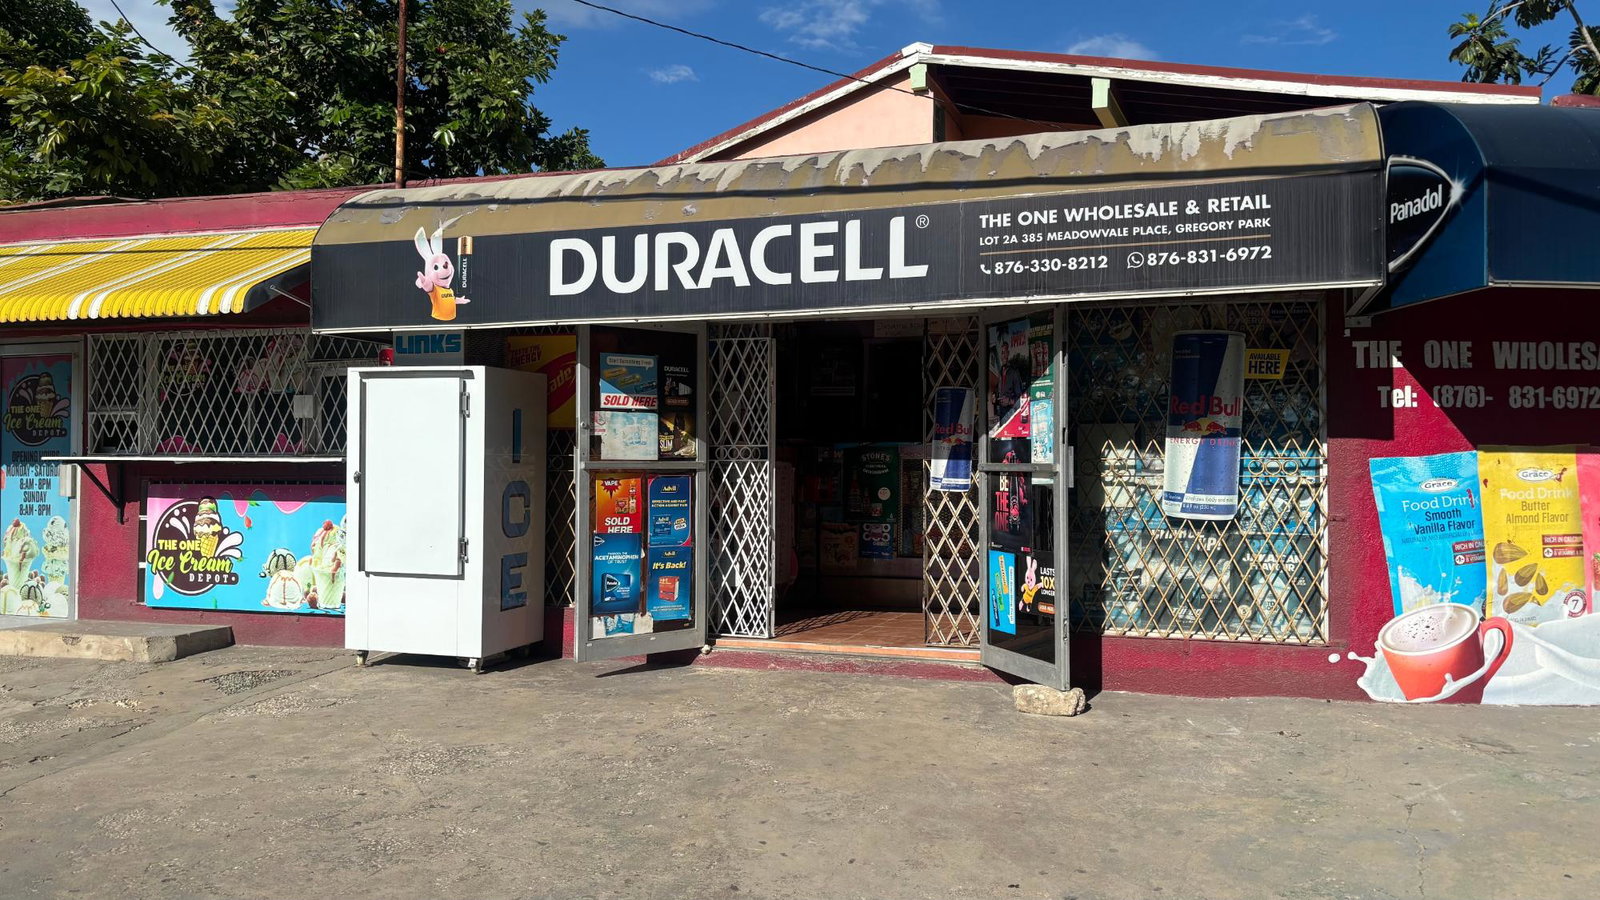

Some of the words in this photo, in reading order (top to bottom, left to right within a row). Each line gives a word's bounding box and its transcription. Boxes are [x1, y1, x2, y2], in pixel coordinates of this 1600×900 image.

[1390, 183, 1443, 224] Panadol
[979, 213, 1011, 228] THE
[1017, 209, 1058, 226] ONE
[1064, 200, 1178, 223] WHOLESALE
[1185, 199, 1201, 214] &
[1208, 194, 1272, 212] RETAIL
[979, 235, 1000, 246] LOT
[1002, 234, 1018, 245] 2A
[1021, 232, 1043, 244] 385
[1046, 226, 1129, 241] MEADOWVALE
[1133, 224, 1172, 237] PLACE,
[1175, 220, 1235, 234] GREGORY
[1238, 217, 1272, 229] PARK
[549, 215, 929, 296] DURACELL
[1146, 246, 1272, 266] 876-831-6972
[994, 256, 1108, 275] 876-330-8212
[461, 257, 469, 289] DURACELL
[395, 333, 462, 355] LINKS
[1249, 353, 1281, 361] AVAILABLE
[1352, 340, 1404, 369] THE
[1423, 339, 1473, 369] ONE
[1492, 340, 1600, 370] WHOLES
[1248, 360, 1281, 374] HERE
[603, 395, 630, 406] SOLD
[631, 396, 657, 407] HERE
[1376, 385, 1418, 408] Tel:
[1432, 384, 1494, 408] (876)-
[1508, 385, 1600, 409] 831-6972
[10, 405, 25, 414] THE
[1170, 394, 1206, 416] Red
[1208, 396, 1241, 417] Bull
[3, 412, 23, 431] Ice
[25, 412, 63, 431] Cream
[935, 422, 955, 435] Red
[1169, 437, 1206, 446] ENERGY
[12, 450, 38, 462] OPENING
[6, 464, 30, 477] MONDAY
[1521, 470, 1549, 478] Grace
[38, 478, 52, 490] 8PM
[999, 475, 1010, 492] BE
[1424, 481, 1452, 489] Grace
[23, 491, 47, 503] SUNDAY
[1499, 487, 1535, 501] Food
[1537, 486, 1573, 500] Drink
[995, 491, 1010, 512] THE
[1401, 496, 1440, 513] Food
[1521, 501, 1551, 512] Butter
[38, 504, 52, 516] 8PM
[1424, 507, 1462, 522] Smooth
[604, 516, 630, 526] SOLD
[994, 512, 1010, 532] ONE
[1506, 512, 1540, 524] Almond
[1542, 511, 1569, 523] Flavor
[607, 525, 634, 533] HERE
[1413, 522, 1446, 535] Vanilla
[1447, 520, 1476, 531] Flavor
[157, 539, 180, 551] THE
[181, 539, 202, 552] ONE
[1455, 543, 1468, 551] RICH
[147, 549, 176, 573] Ice
[179, 549, 233, 574] Cream
[652, 561, 665, 570] It's
[665, 560, 688, 569] Back!
[189, 573, 229, 583] DEPOT
[1040, 575, 1056, 590] 10X
[1571, 599, 1579, 610] 7
